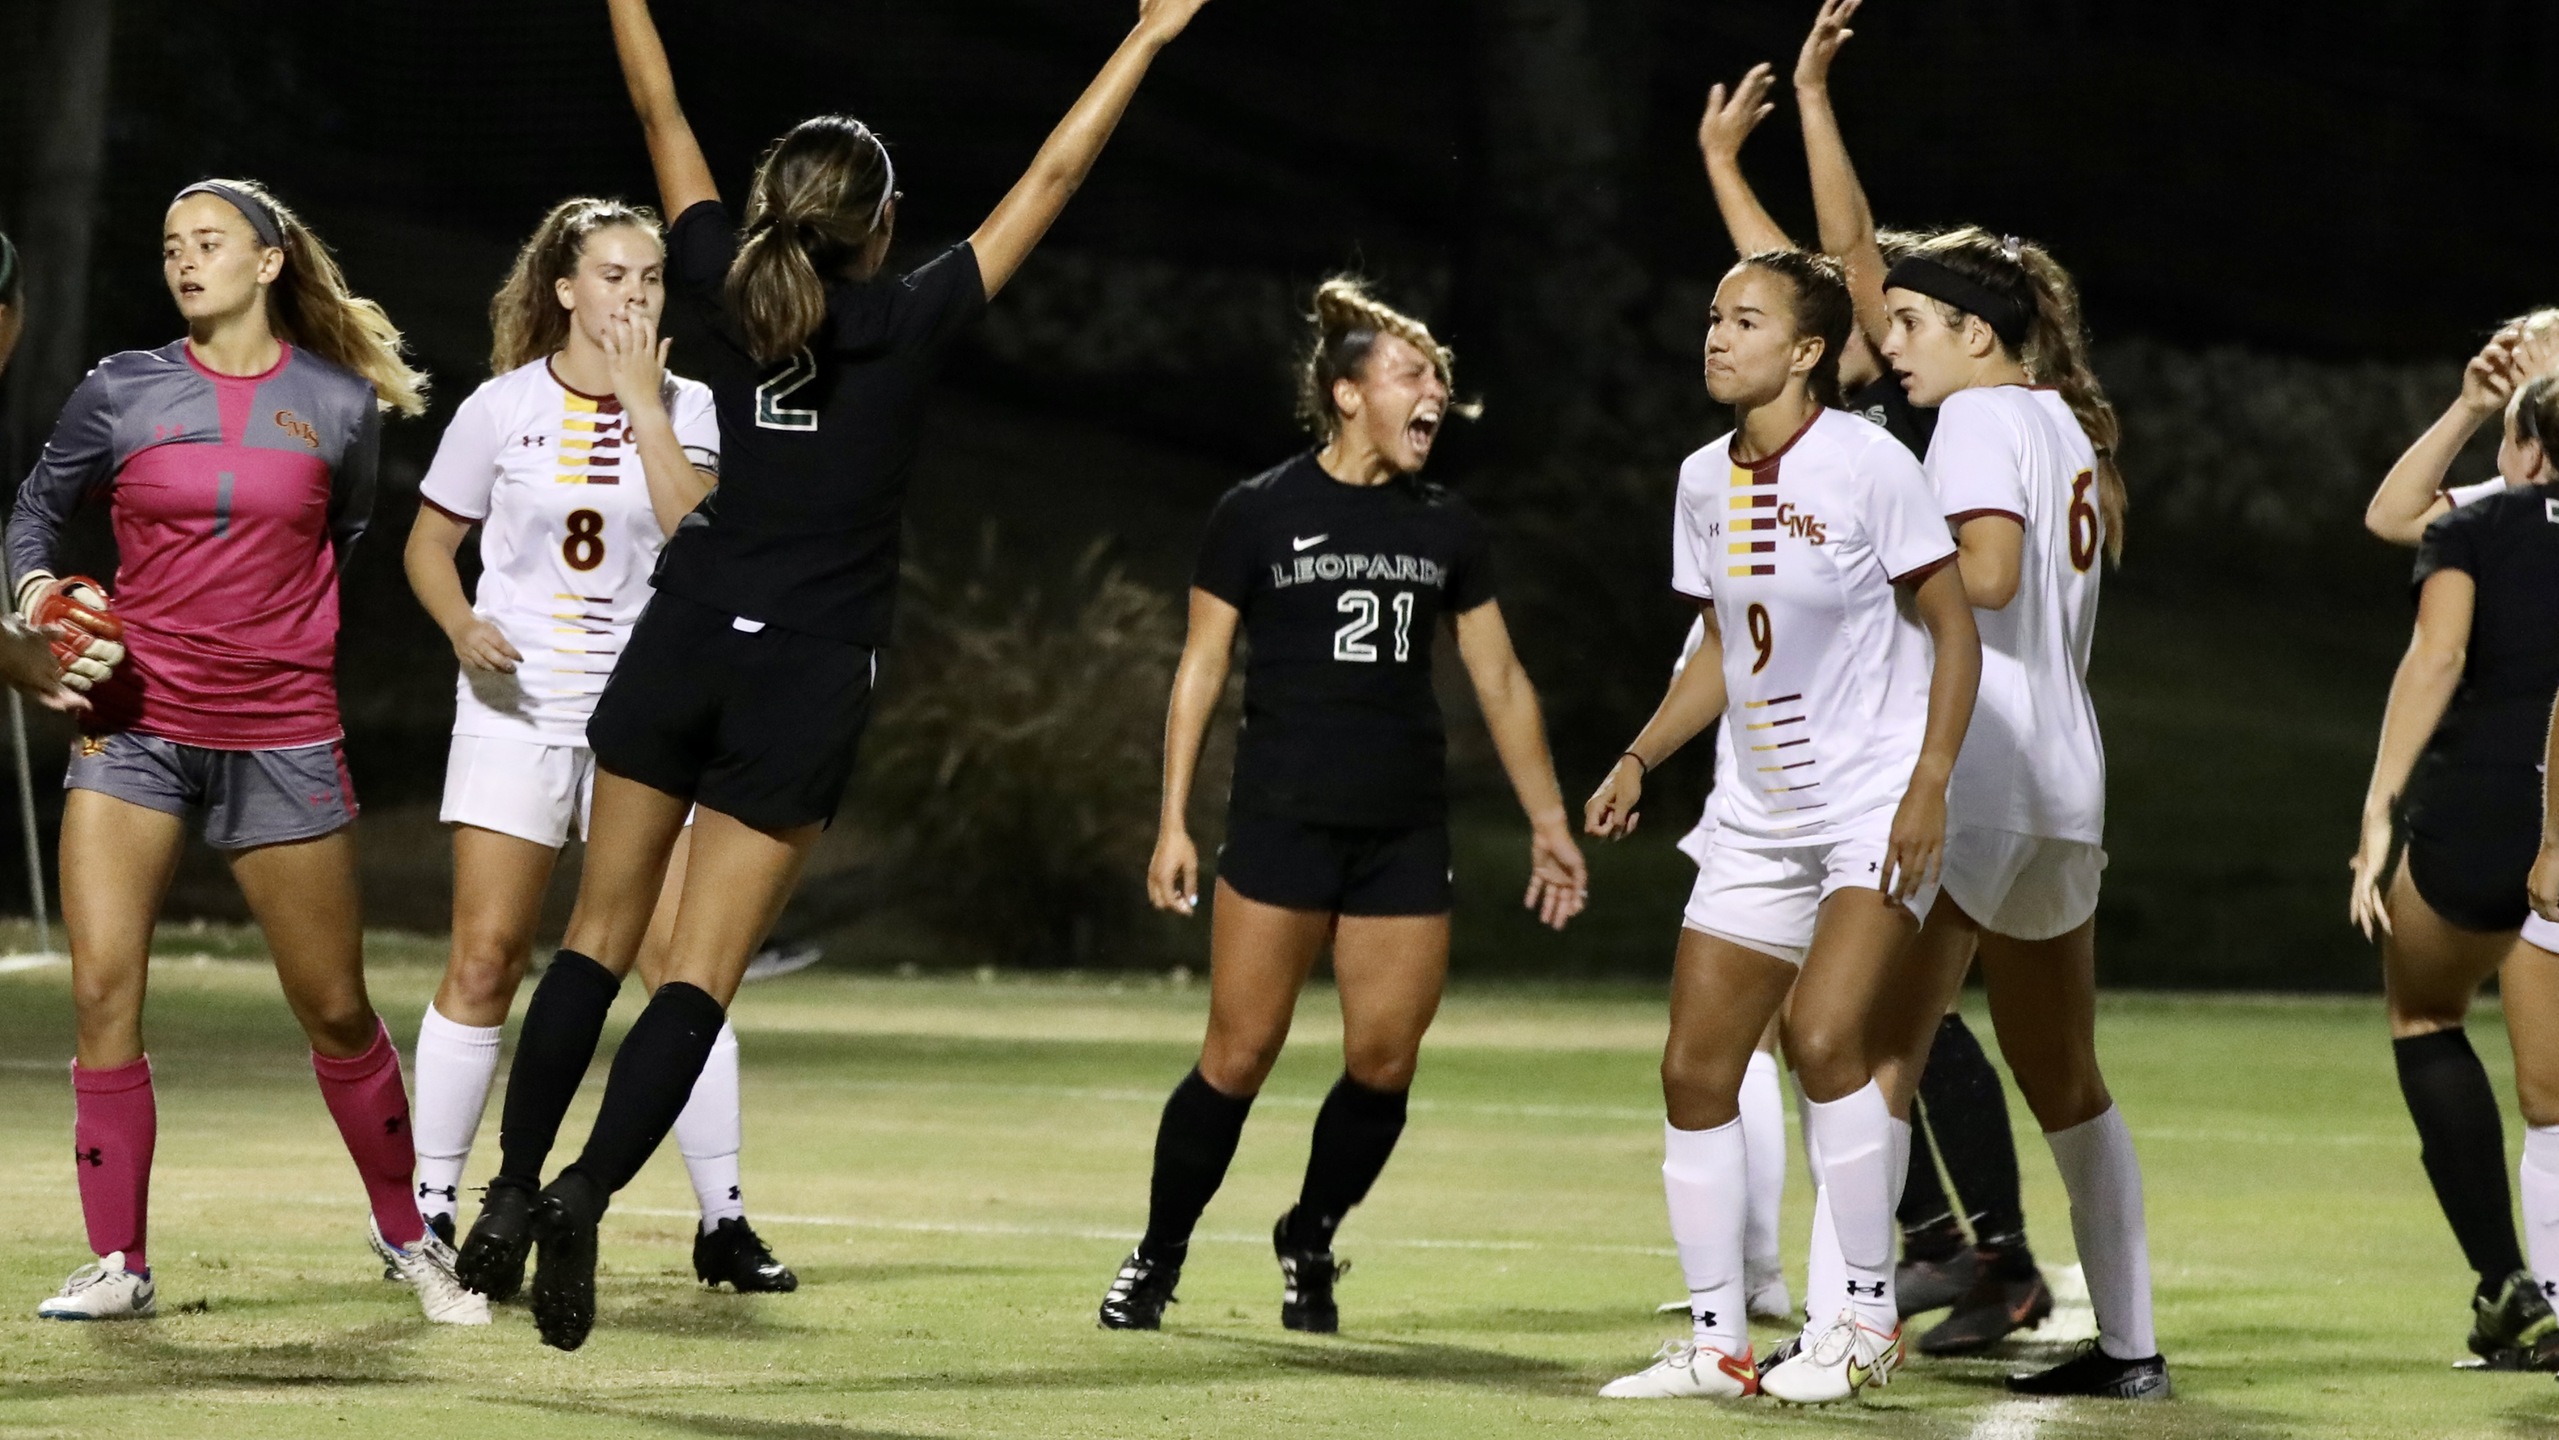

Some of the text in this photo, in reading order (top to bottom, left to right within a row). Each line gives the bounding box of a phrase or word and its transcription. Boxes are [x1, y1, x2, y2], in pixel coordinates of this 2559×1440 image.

[274, 409, 319, 448] CMS
[212, 470, 235, 539] 1
[1777, 503, 1827, 546] CMS
[2068, 467, 2097, 575] 6
[562, 507, 606, 573] 8
[1333, 589, 1414, 662] 21
[1748, 602, 1773, 676] 9
